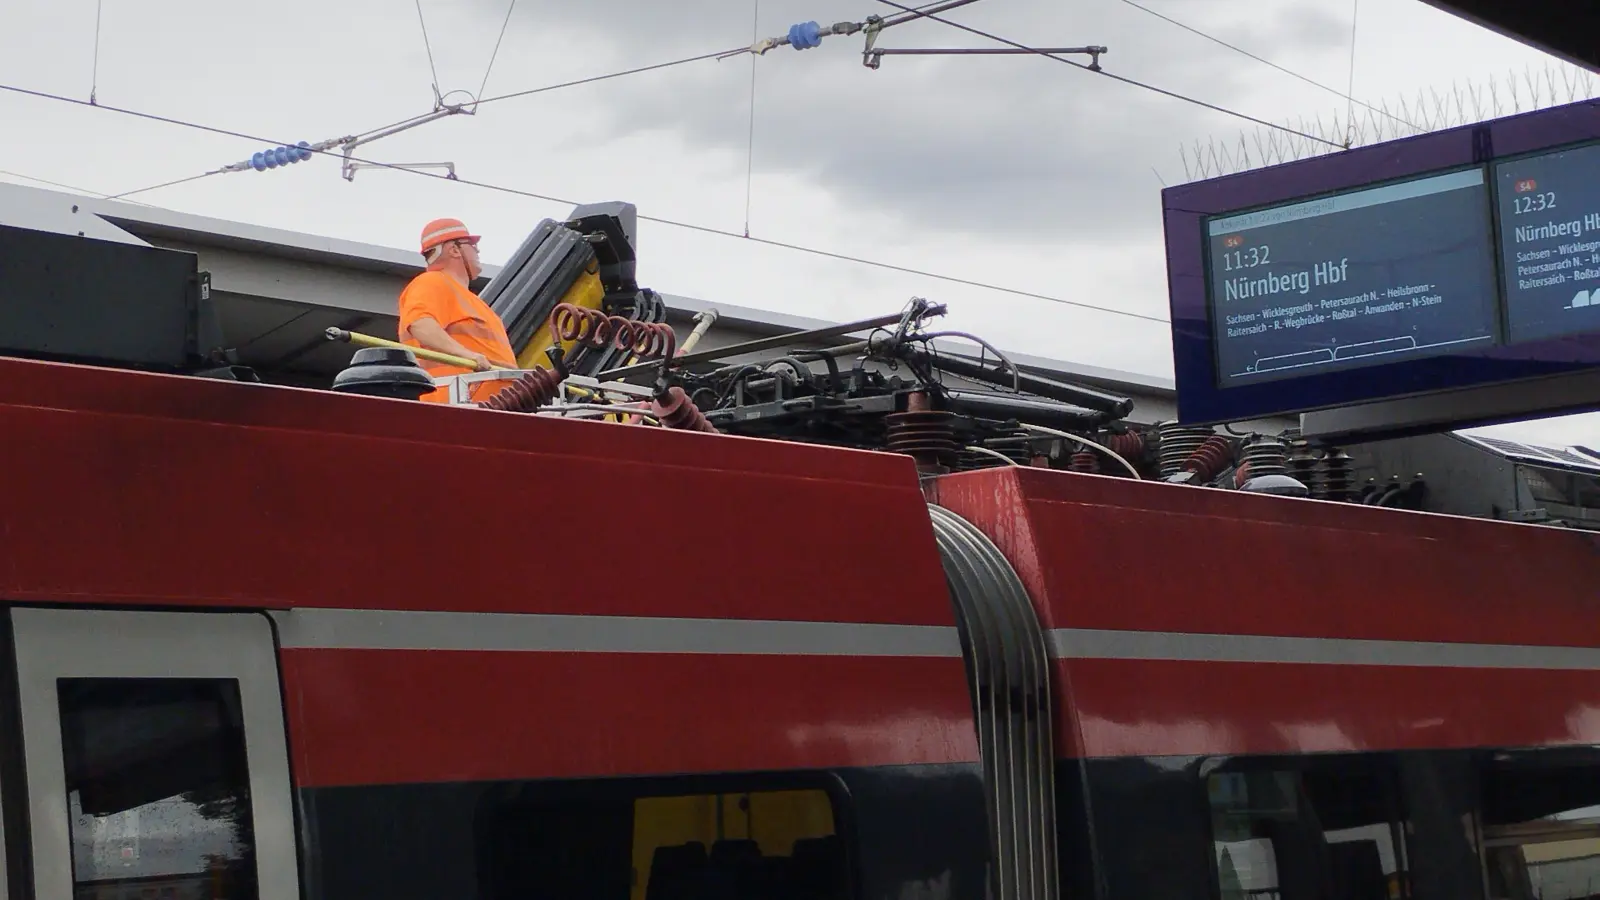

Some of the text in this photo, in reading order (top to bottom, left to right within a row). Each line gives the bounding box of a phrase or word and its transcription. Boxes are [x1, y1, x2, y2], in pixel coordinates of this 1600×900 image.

[1513, 191, 1556, 214] 12:32
[1515, 220, 1581, 243] Nürnberg
[1223, 245, 1270, 271] 11:32
[1516, 249, 1551, 263] Sachsen
[1517, 258, 1572, 276] Petersaurach
[1573, 256, 1583, 267] N.
[1224, 258, 1348, 301] Nürnberg Hbf
[1518, 273, 1565, 290] Raitersaich
[1226, 313, 1255, 325] Sachsen
[1261, 302, 1313, 319] Wicklesgreuth
[1320, 292, 1369, 309] Petersaurach
[1370, 291, 1379, 301] N.
[1387, 284, 1429, 298] Heilsbronn
[1227, 322, 1267, 337] Raitersaich
[1274, 314, 1325, 330] R.-Wegbrücke
[1332, 307, 1357, 320] Roßtal
[1365, 301, 1405, 315] Anwanden
[1412, 294, 1442, 307] N-Stein
